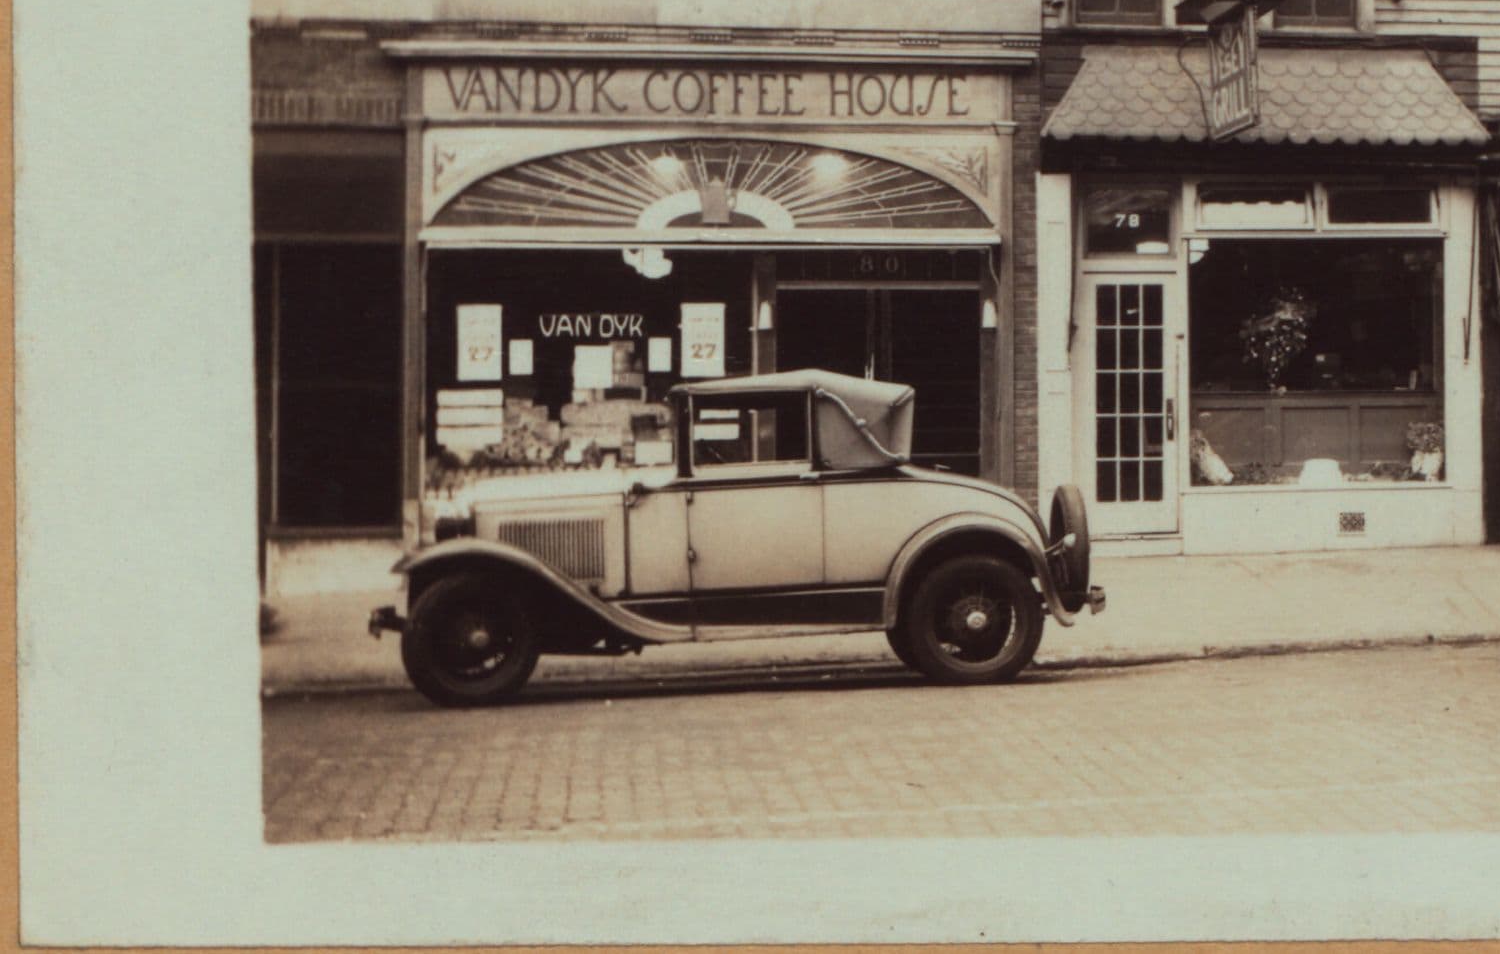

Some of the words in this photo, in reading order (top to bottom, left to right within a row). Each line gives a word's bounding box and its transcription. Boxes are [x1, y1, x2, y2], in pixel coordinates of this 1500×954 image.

[643, 69, 807, 118] COFFEE
[827, 72, 970, 118] HOUSE
[1114, 213, 1140, 229] 78
[538, 313, 592, 337] VAN
[599, 313, 644, 339] DYK
[690, 342, 718, 360] 27
